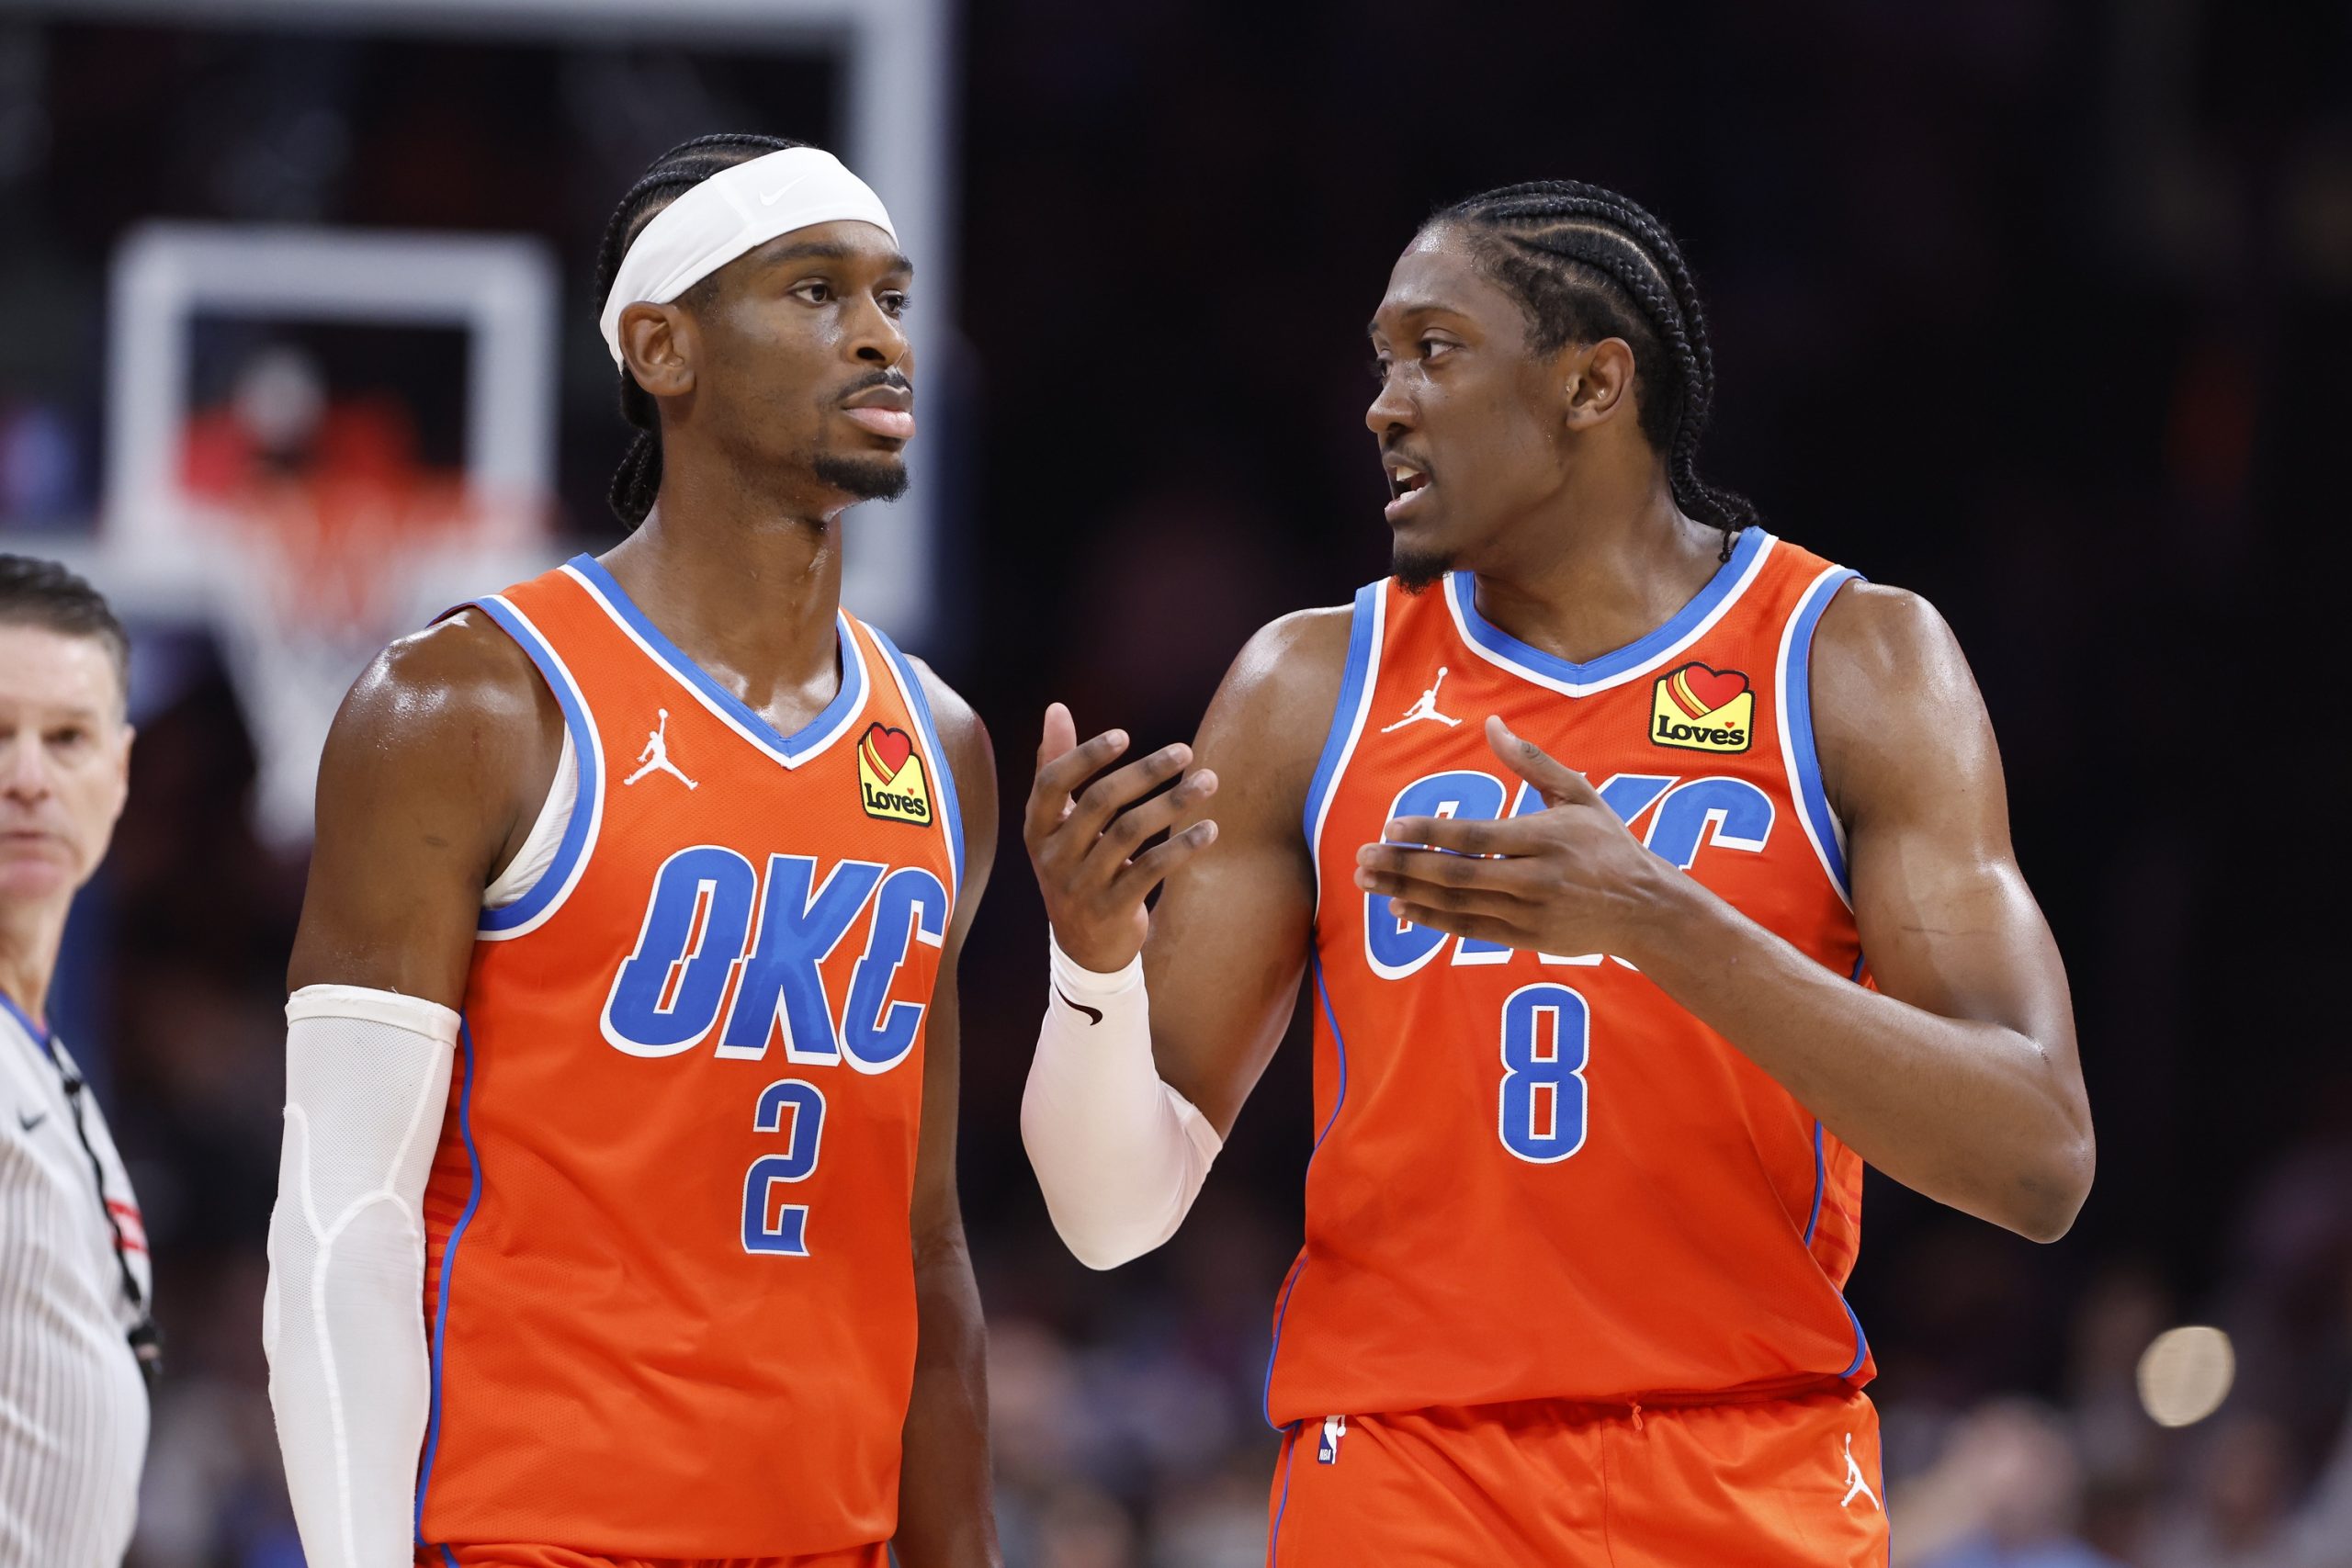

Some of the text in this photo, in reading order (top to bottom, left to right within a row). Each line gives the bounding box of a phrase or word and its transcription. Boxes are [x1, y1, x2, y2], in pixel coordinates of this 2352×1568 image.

[600, 845, 948, 1075] OKC
[1498, 982, 1589, 1164] 8
[740, 1077, 827, 1257] 2
[1318, 1449, 1331, 1461] NBA
